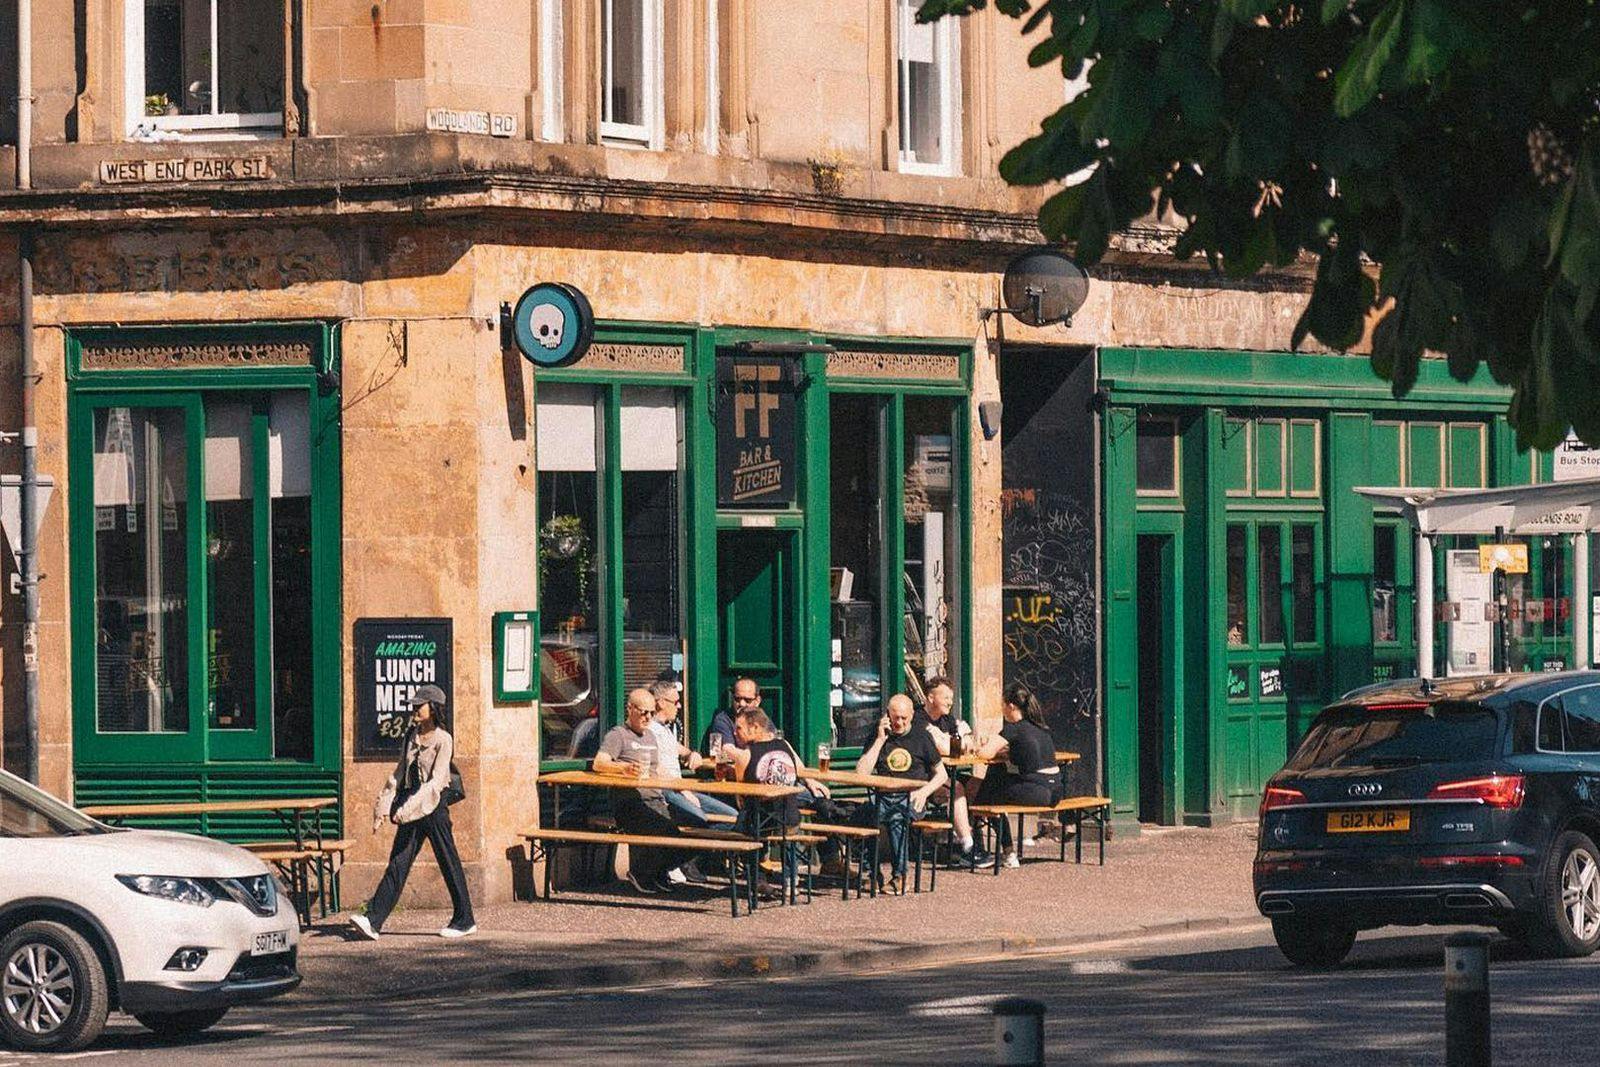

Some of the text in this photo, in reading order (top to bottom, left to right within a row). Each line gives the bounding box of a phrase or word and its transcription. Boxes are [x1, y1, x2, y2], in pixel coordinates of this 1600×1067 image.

[429, 110, 489, 131] WOODLANDS
[106, 158, 266, 180] WEST END PARK ST.
[734, 364, 781, 438] FF
[740, 444, 772, 467] BAR &
[1560, 456, 1577, 465] Bus
[734, 465, 781, 493] KITCHEN
[375, 641, 437, 656] AMAZING
[375, 658, 436, 682] LUNCH
[375, 684, 421, 711] MEN
[1341, 811, 1396, 828] G12 KJR
